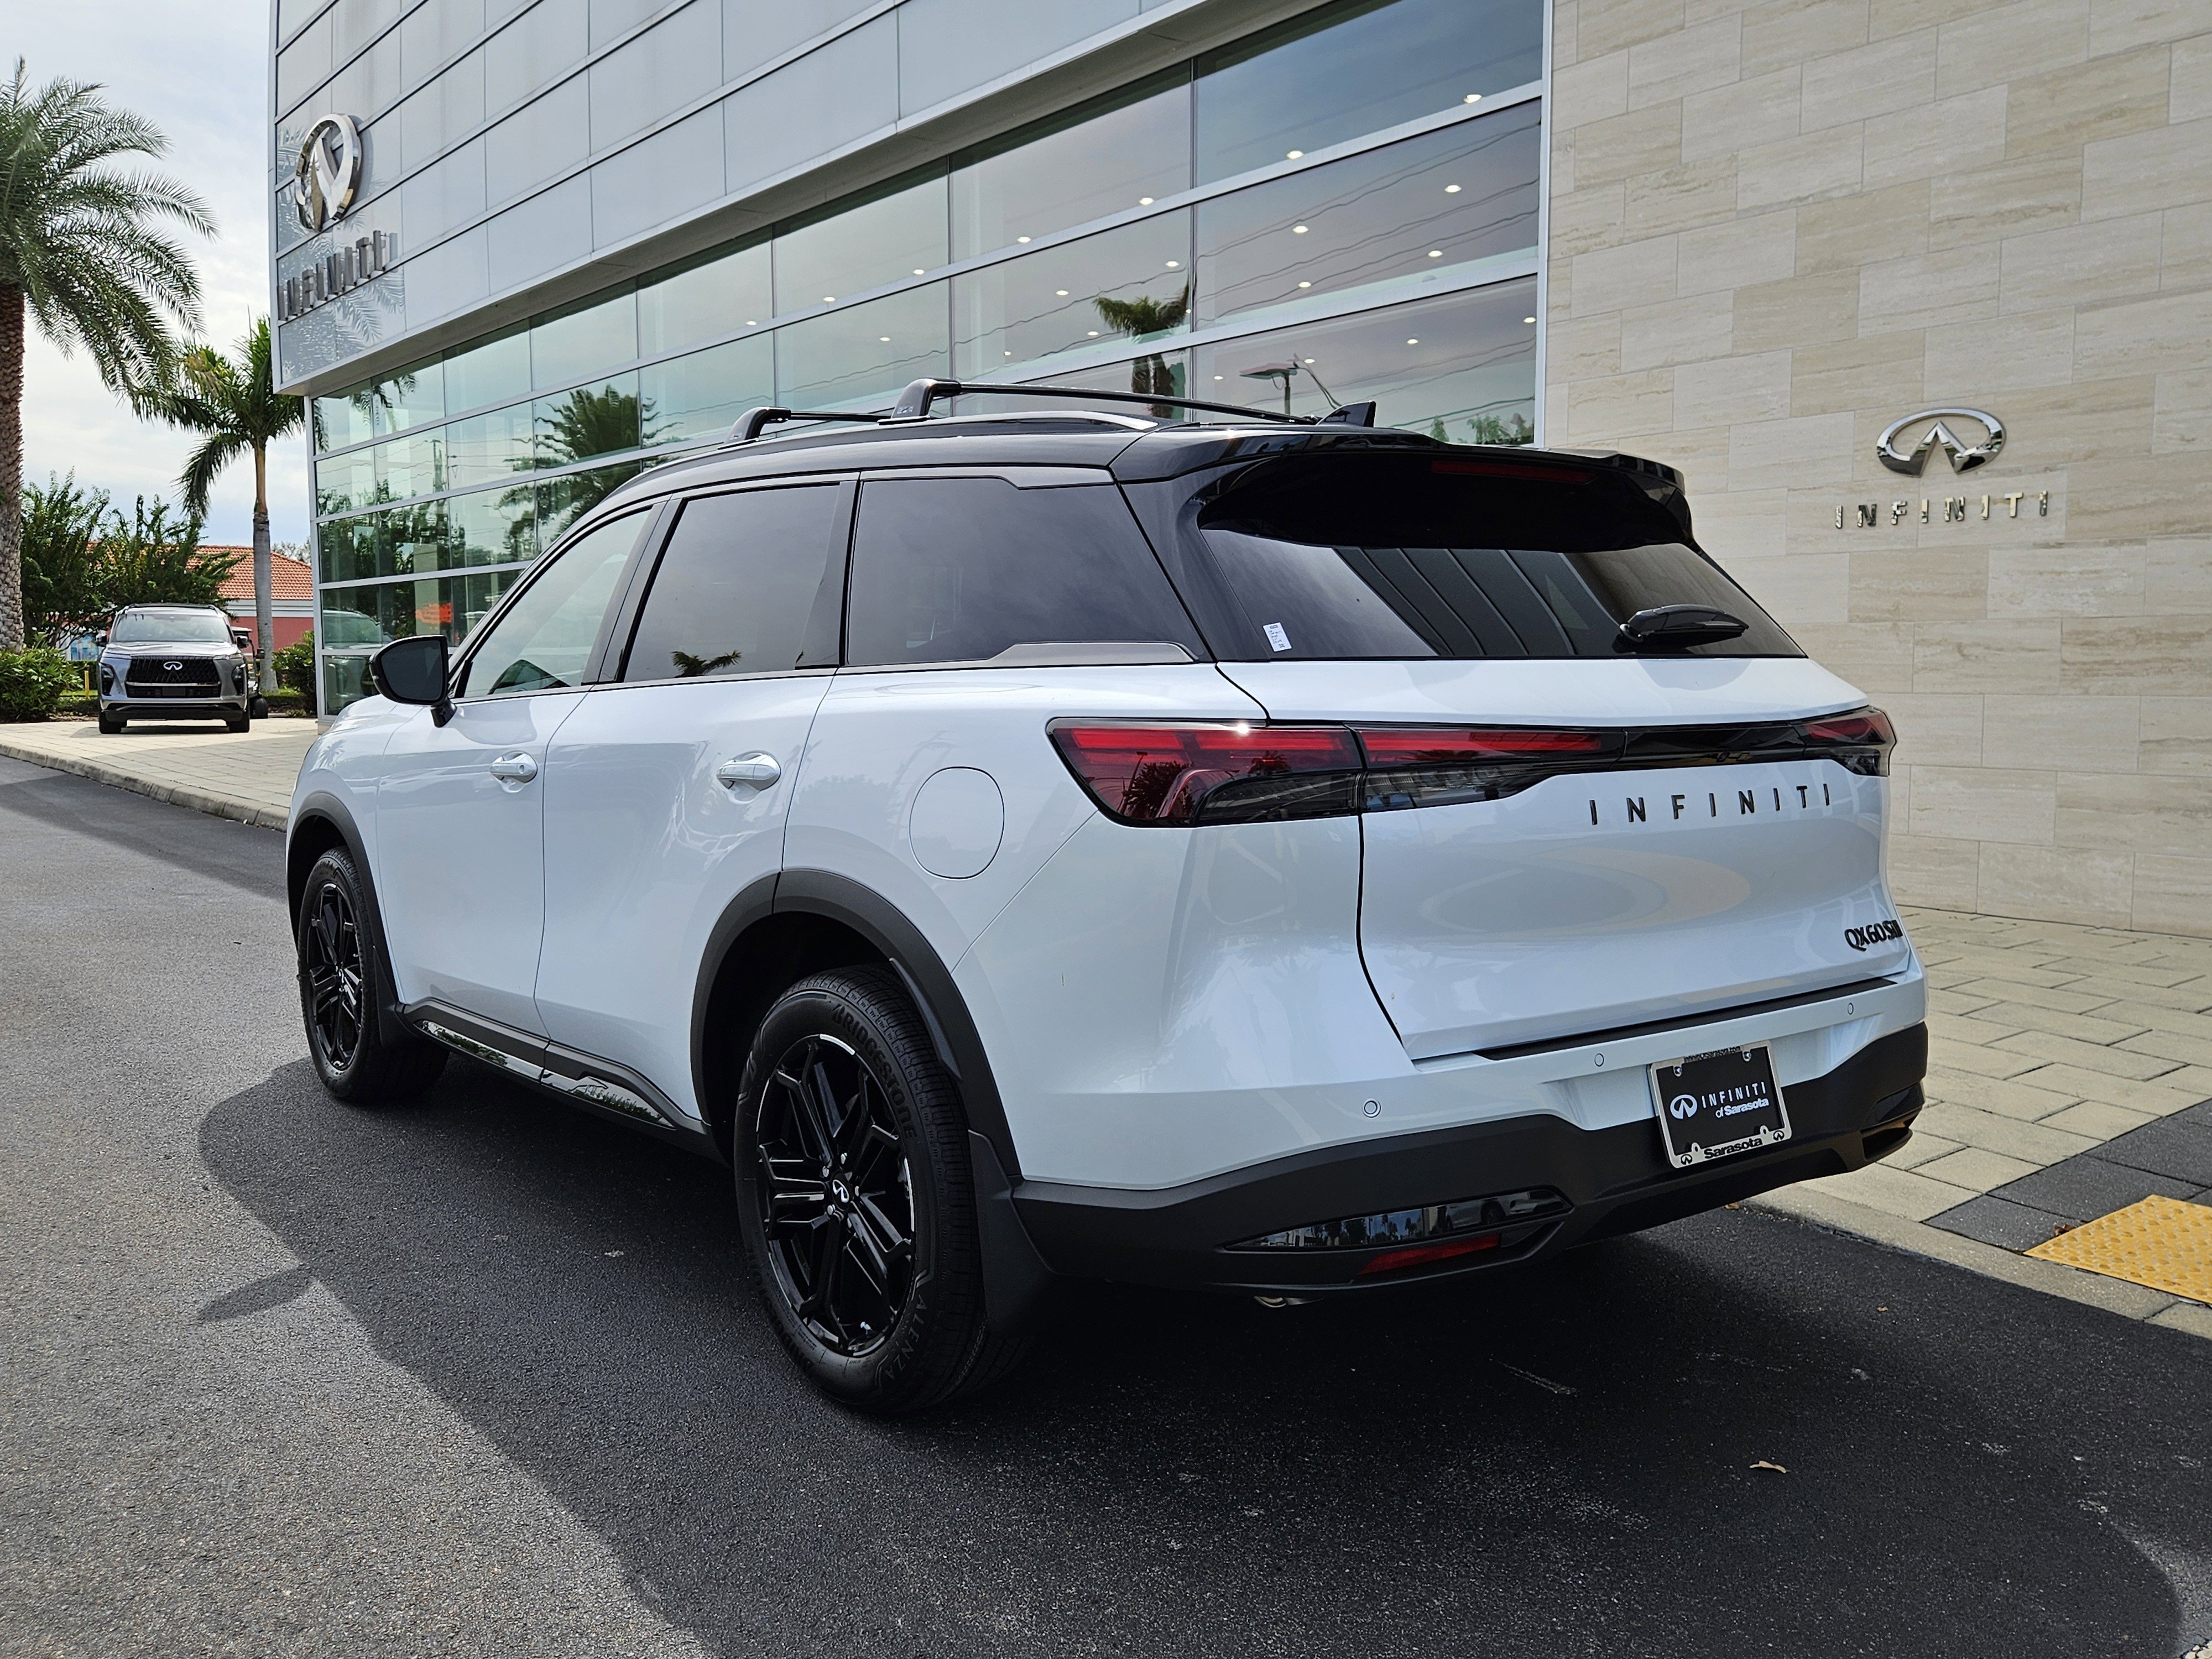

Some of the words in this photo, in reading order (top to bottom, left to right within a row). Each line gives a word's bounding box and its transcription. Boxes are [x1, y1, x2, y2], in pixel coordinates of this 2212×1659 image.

[278, 229, 388, 321] INFINITI
[1835, 490, 2048, 529] INFINITI
[1589, 783, 1830, 826] INFINITI
[832, 1003, 917, 1140] BRIDGESTONE
[1702, 1081, 1766, 1109] INFINITI
[1715, 1107, 1724, 1119] of
[1724, 1098, 1770, 1116] Sarasota
[1704, 1137, 1763, 1160] Sarasota
[885, 1293, 927, 1381] ALENZA
